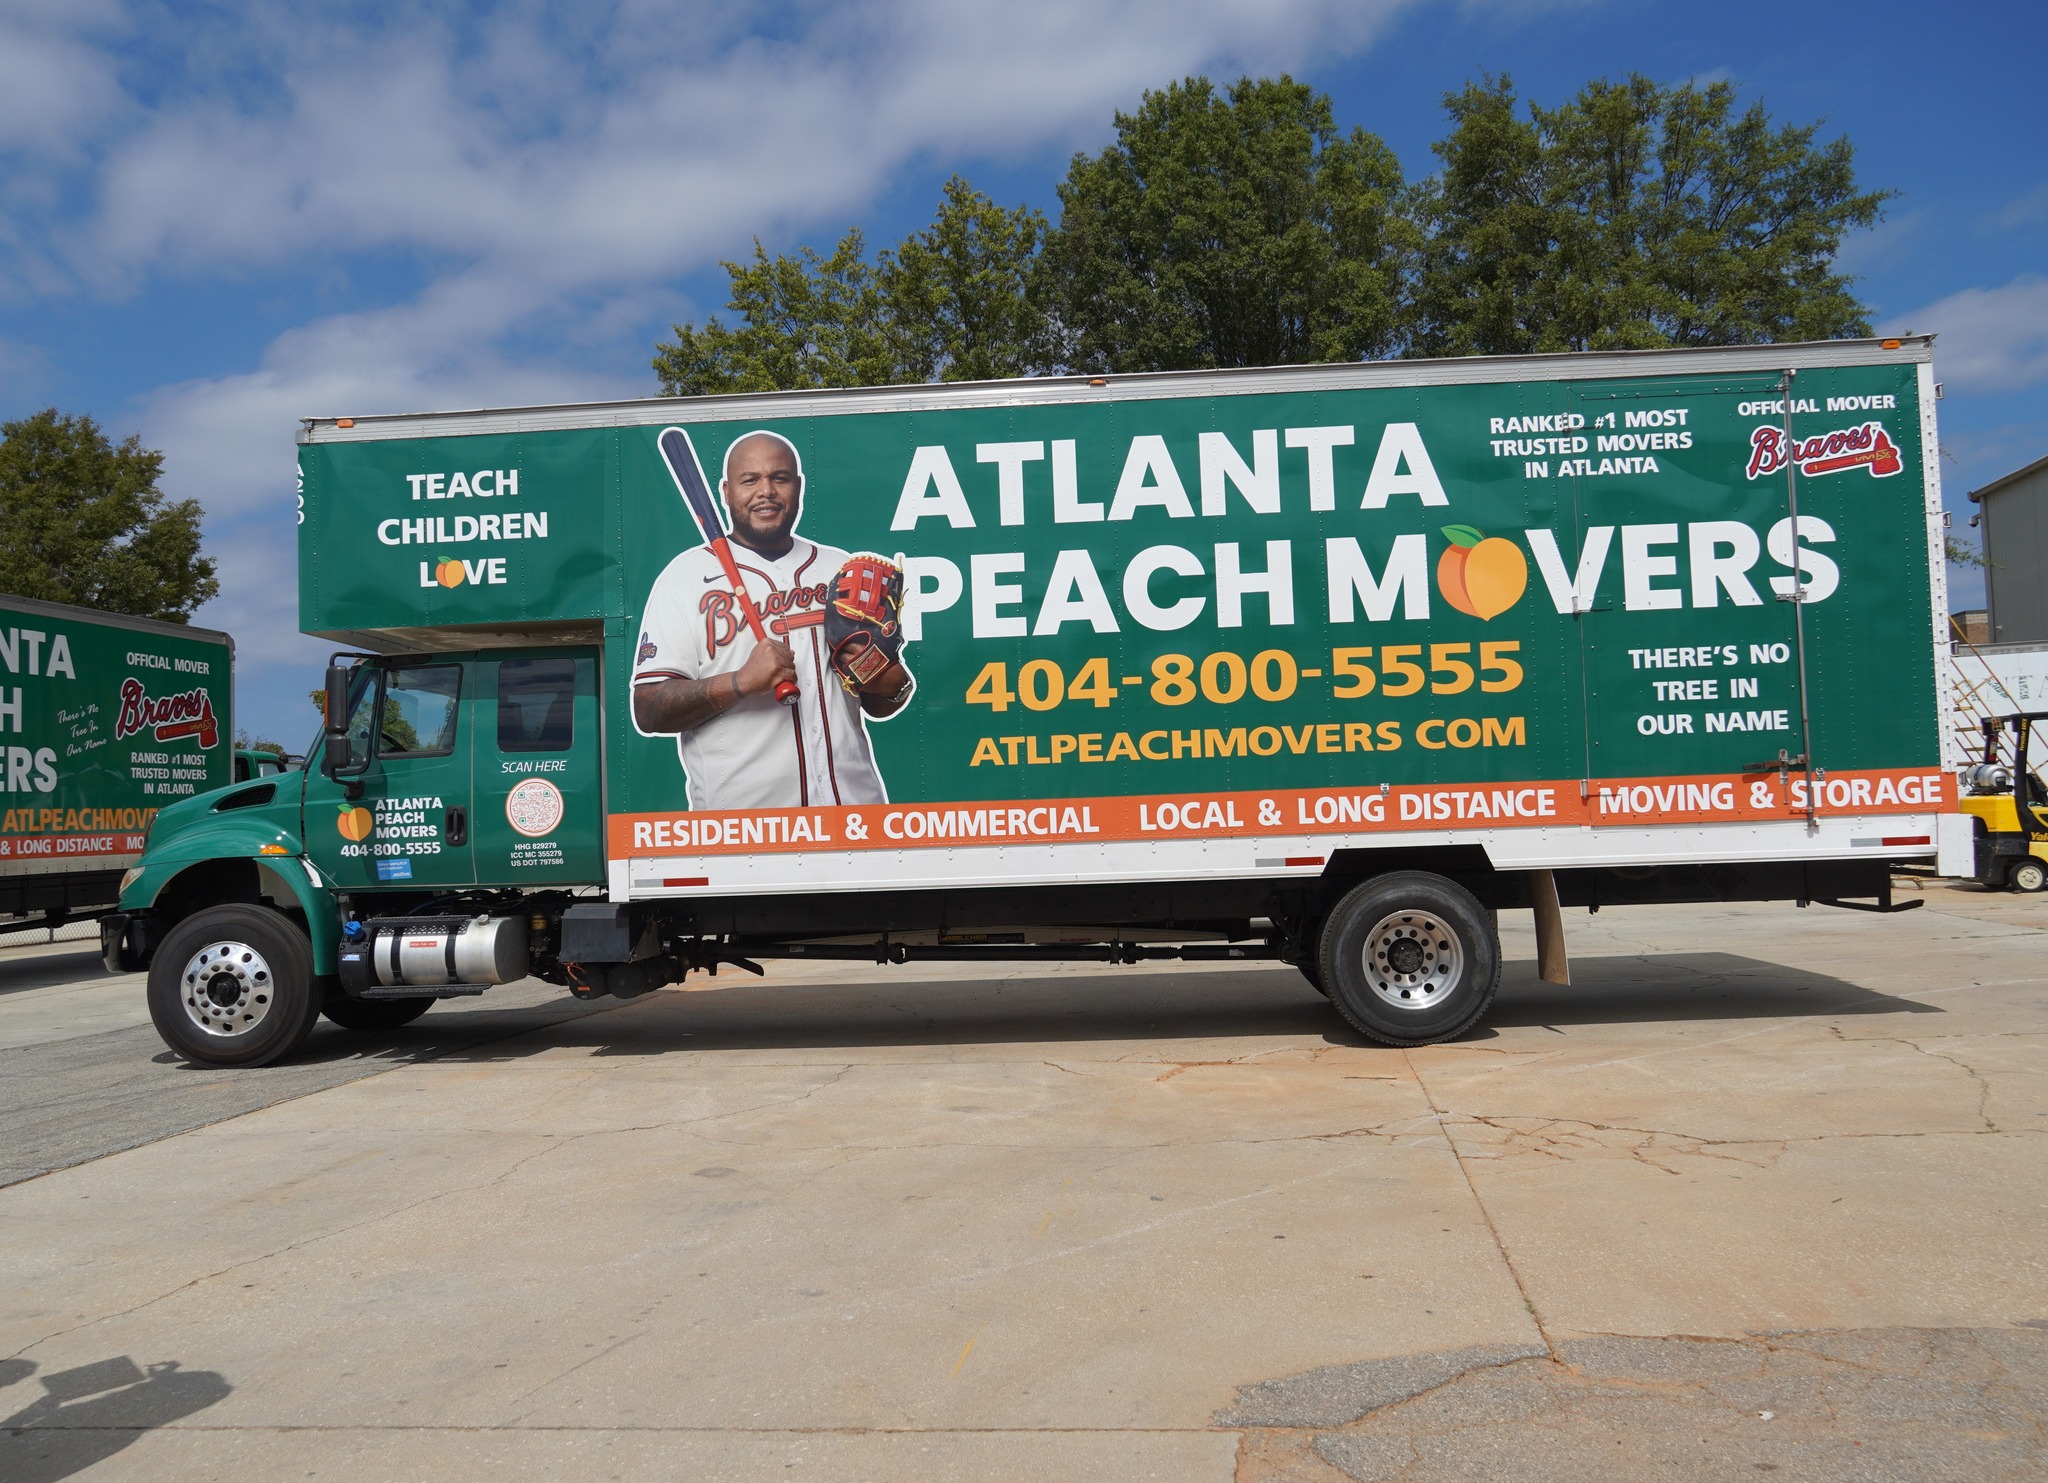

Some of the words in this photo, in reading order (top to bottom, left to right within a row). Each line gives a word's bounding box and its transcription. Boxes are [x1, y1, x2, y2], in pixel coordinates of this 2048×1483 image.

[1738, 399, 1820, 416] OFFICIAL
[1827, 395, 1895, 411] MOVER
[1491, 414, 1584, 434] RANKED
[1595, 413, 1615, 428] #1
[1625, 409, 1688, 427] MOST
[1490, 437, 1588, 456] TRUSTED
[1597, 432, 1692, 451] MOVERS
[1747, 423, 1872, 479] Braves
[890, 423, 1449, 531] ATLANTA
[1526, 462, 1548, 478] IN
[1558, 457, 1659, 477] ATLANTA
[407, 470, 518, 500] TEACH
[378, 512, 547, 545] CHILDREN
[905, 540, 1294, 641] PEACH
[699, 582, 828, 660] Brave
[126, 651, 172, 671] OFFICIAL
[174, 657, 211, 676] MOVER
[1628, 646, 1738, 668] THERE'S
[1750, 643, 1789, 664] NO
[966, 640, 1524, 711] 404-800-5555
[1653, 680, 1718, 701] TREE
[1731, 678, 1758, 698] IN
[117, 679, 202, 741] Braves
[1638, 714, 1693, 735] OUR
[1705, 710, 1788, 732] NAME
[970, 721, 1402, 766] ATLPEACHMOVERS
[1416, 717, 1525, 749] COM
[0, 745, 57, 793] RS
[130, 751, 169, 765] RANKED
[171, 753, 181, 765] #1
[182, 754, 207, 766] MOST
[501, 761, 532, 773] SCAN
[534, 760, 568, 772] HERE
[130, 767, 170, 780] TRUSTED
[172, 768, 208, 780] MOVERS
[143, 782, 155, 795] IN
[156, 783, 196, 795] ATLANTA
[376, 797, 443, 810] ATLANTA
[634, 814, 830, 848] RESIDENTIAL
[846, 814, 868, 840] &
[884, 806, 1100, 840] COMMERCIAL
[1140, 801, 1243, 830] LOCAL
[1258, 799, 1281, 826] &
[1299, 795, 1384, 824] LONG
[1400, 789, 1555, 820] DISTANCE
[1600, 783, 1733, 813] MOVING
[1750, 782, 1774, 808] &
[1791, 776, 1943, 809] STORAGE
[376, 812, 424, 824] PEACH
[377, 825, 437, 838] MOVERS
[2030, 831, 2048, 841] Yal
[0, 840, 11, 856] &
[16, 838, 52, 855] LONG
[55, 836, 114, 853] DISTANCE
[341, 842, 440, 856] 404-800-5555
